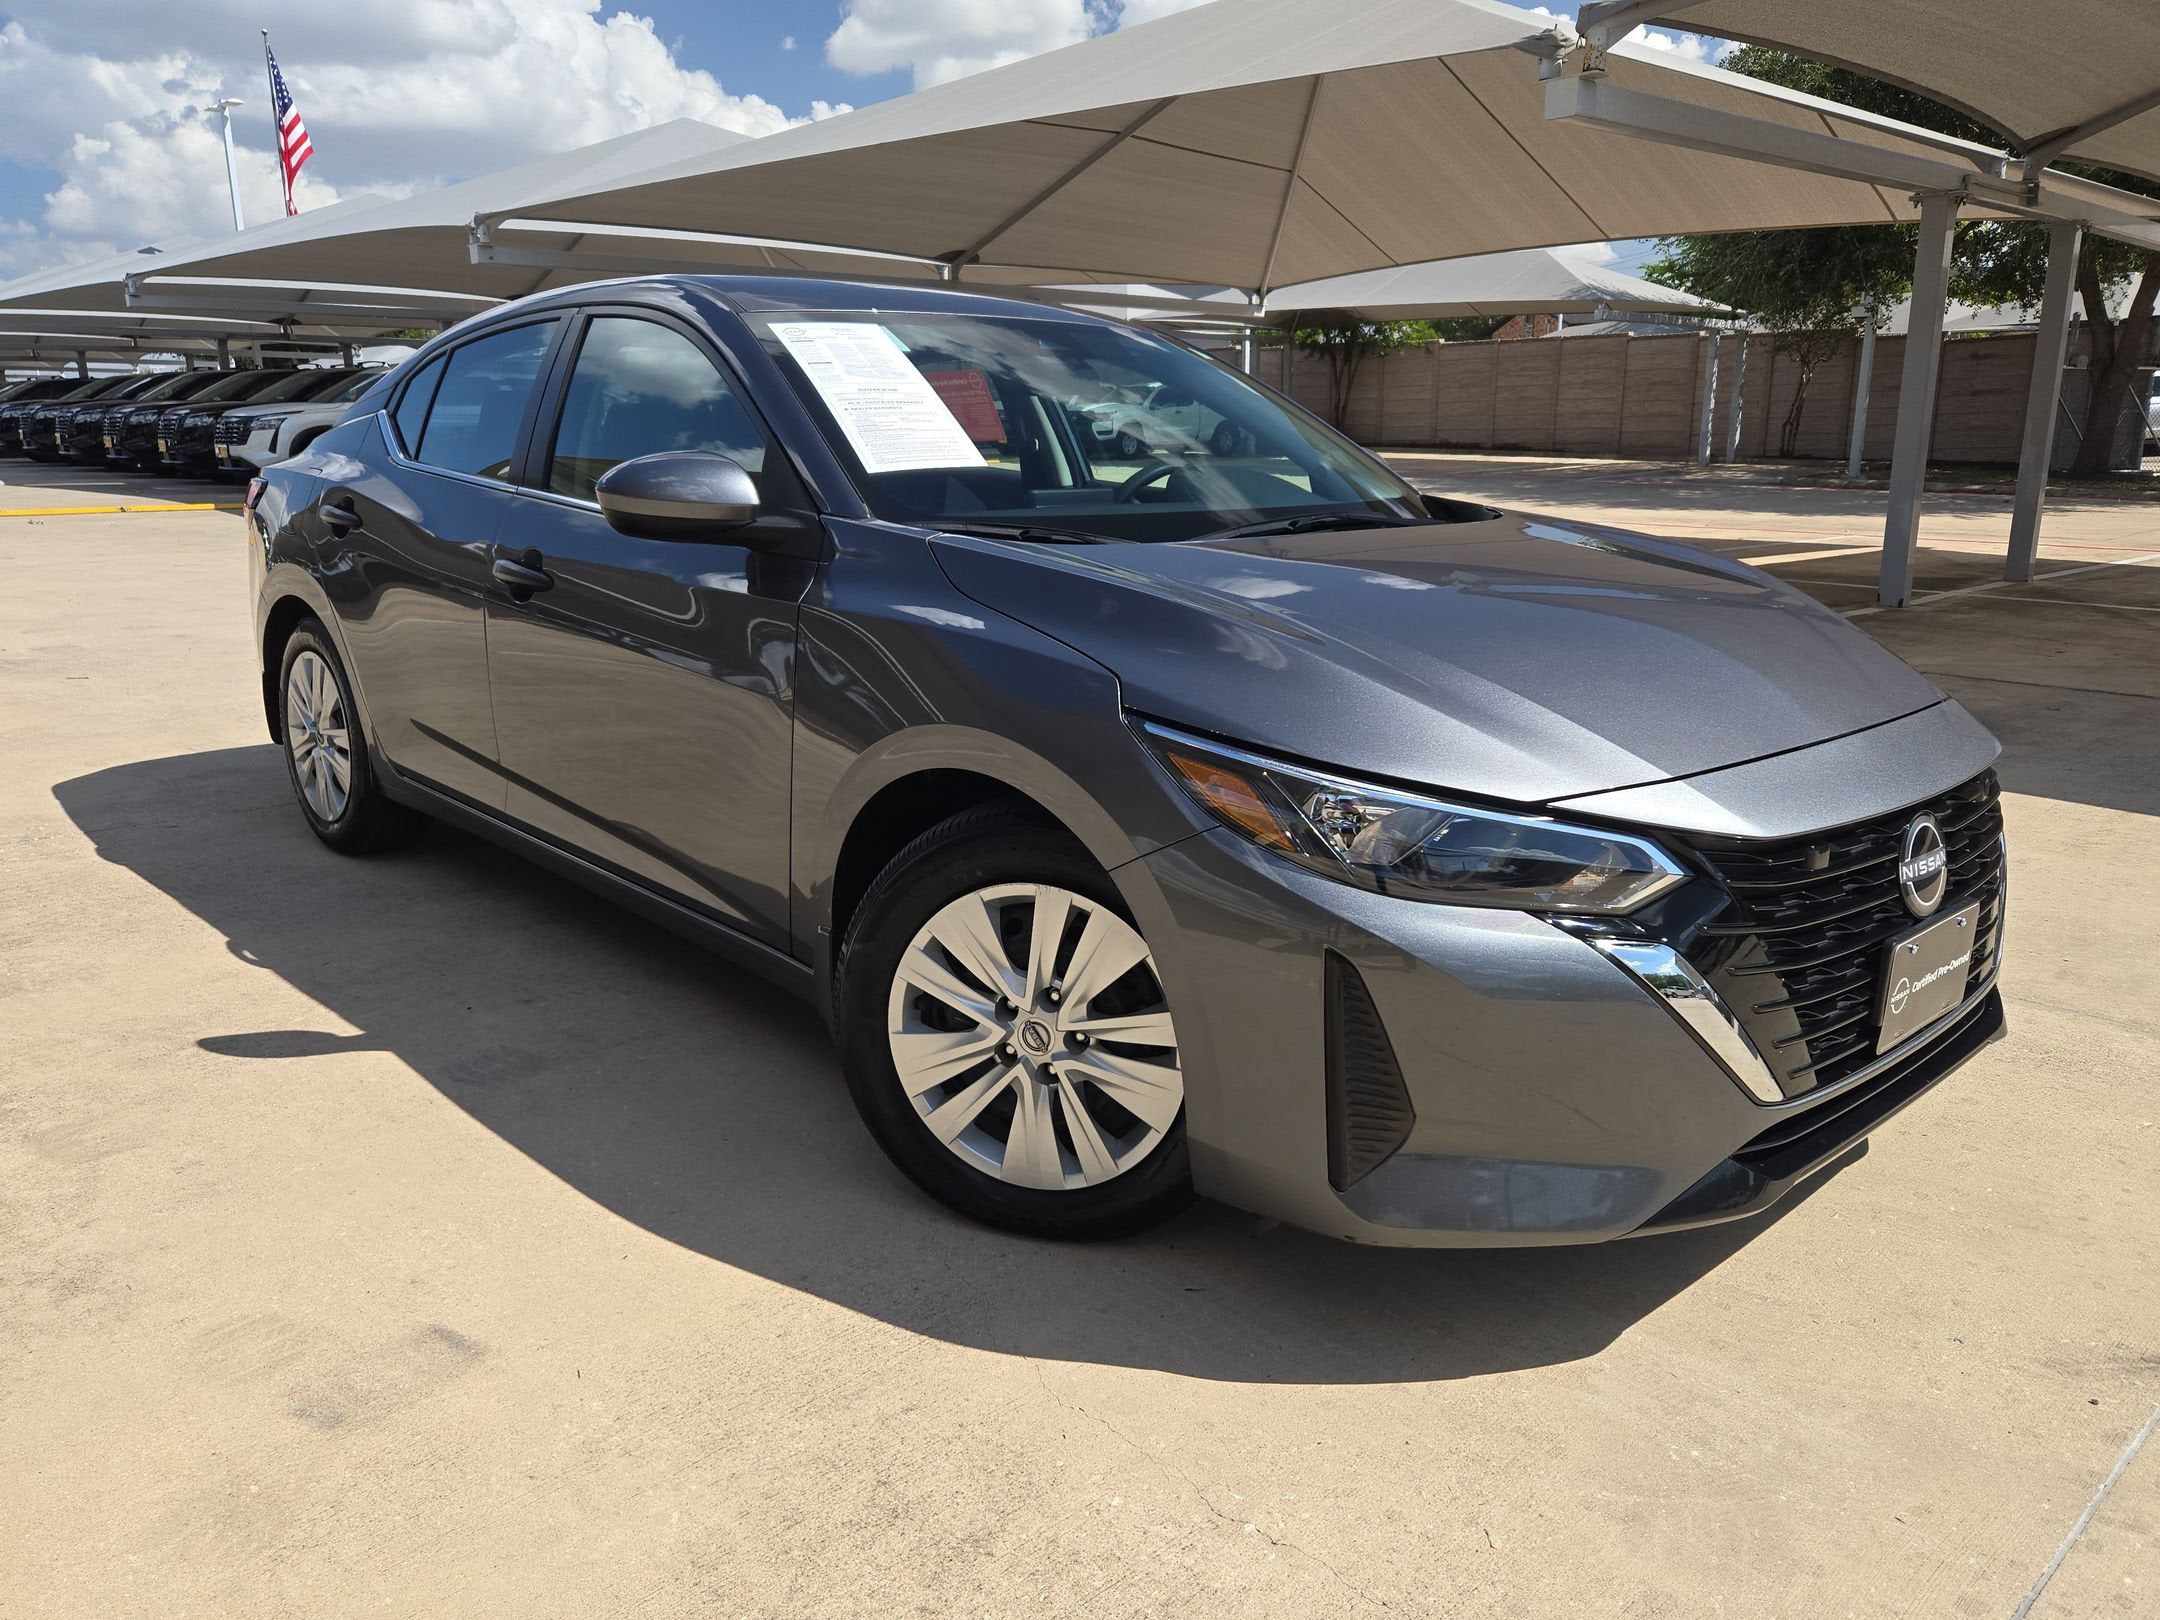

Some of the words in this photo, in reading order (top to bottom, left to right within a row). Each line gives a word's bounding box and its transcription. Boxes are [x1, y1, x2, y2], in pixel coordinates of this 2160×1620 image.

[1902, 849, 1946, 880] NISSAN
[1912, 968, 1939, 993] Certified
[1937, 950, 1970, 978] Pre-Owned
[1891, 988, 1911, 1004] NISSAN
